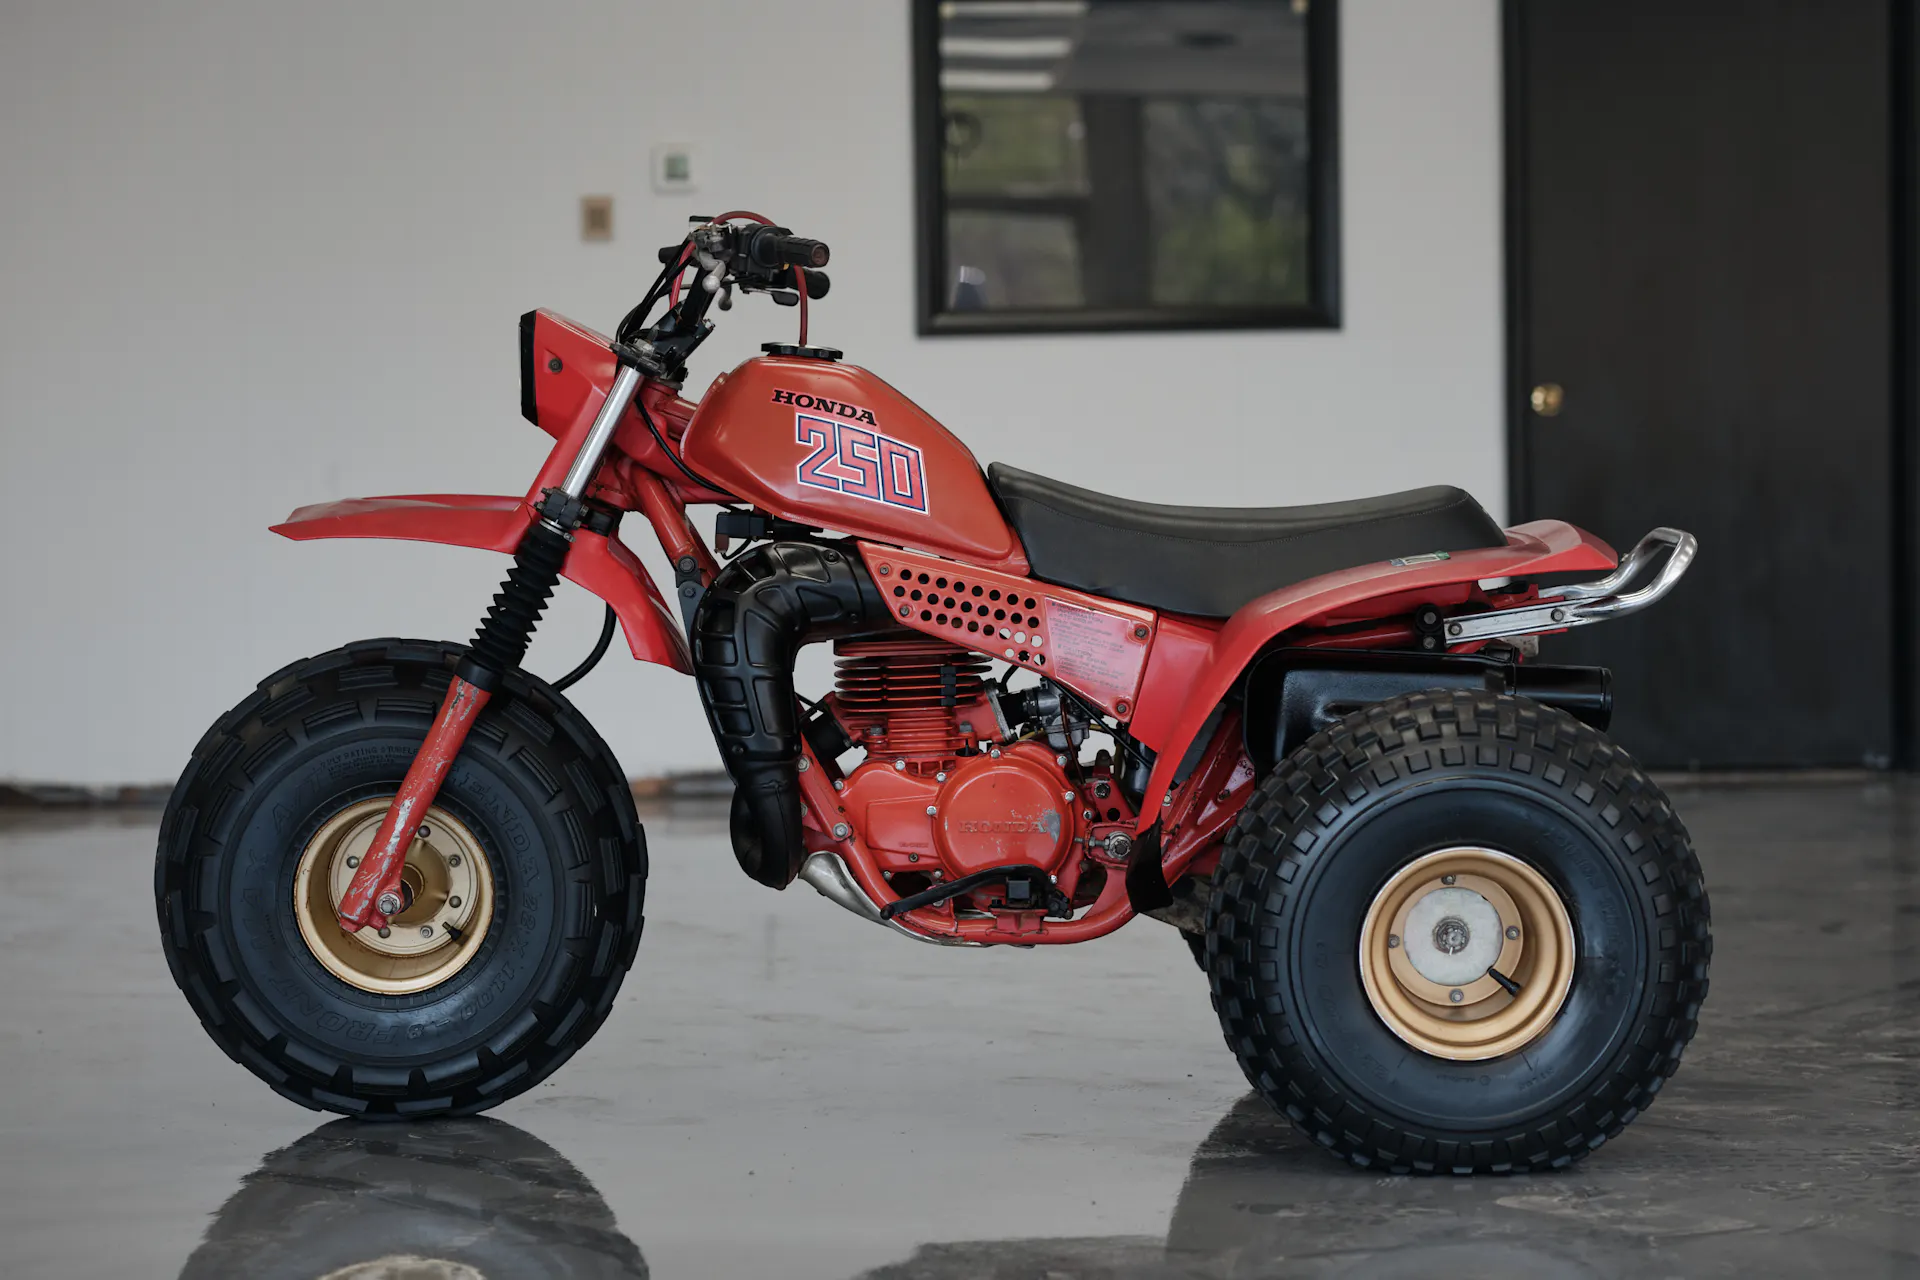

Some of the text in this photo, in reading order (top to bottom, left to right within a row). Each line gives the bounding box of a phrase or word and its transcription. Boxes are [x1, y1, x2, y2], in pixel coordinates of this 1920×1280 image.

[772, 389, 877, 427] HONDA
[796, 412, 930, 515] 250
[343, 747, 378, 760] RATING
[958, 820, 1048, 834] HONDA
[270, 970, 398, 1045] FRONT
